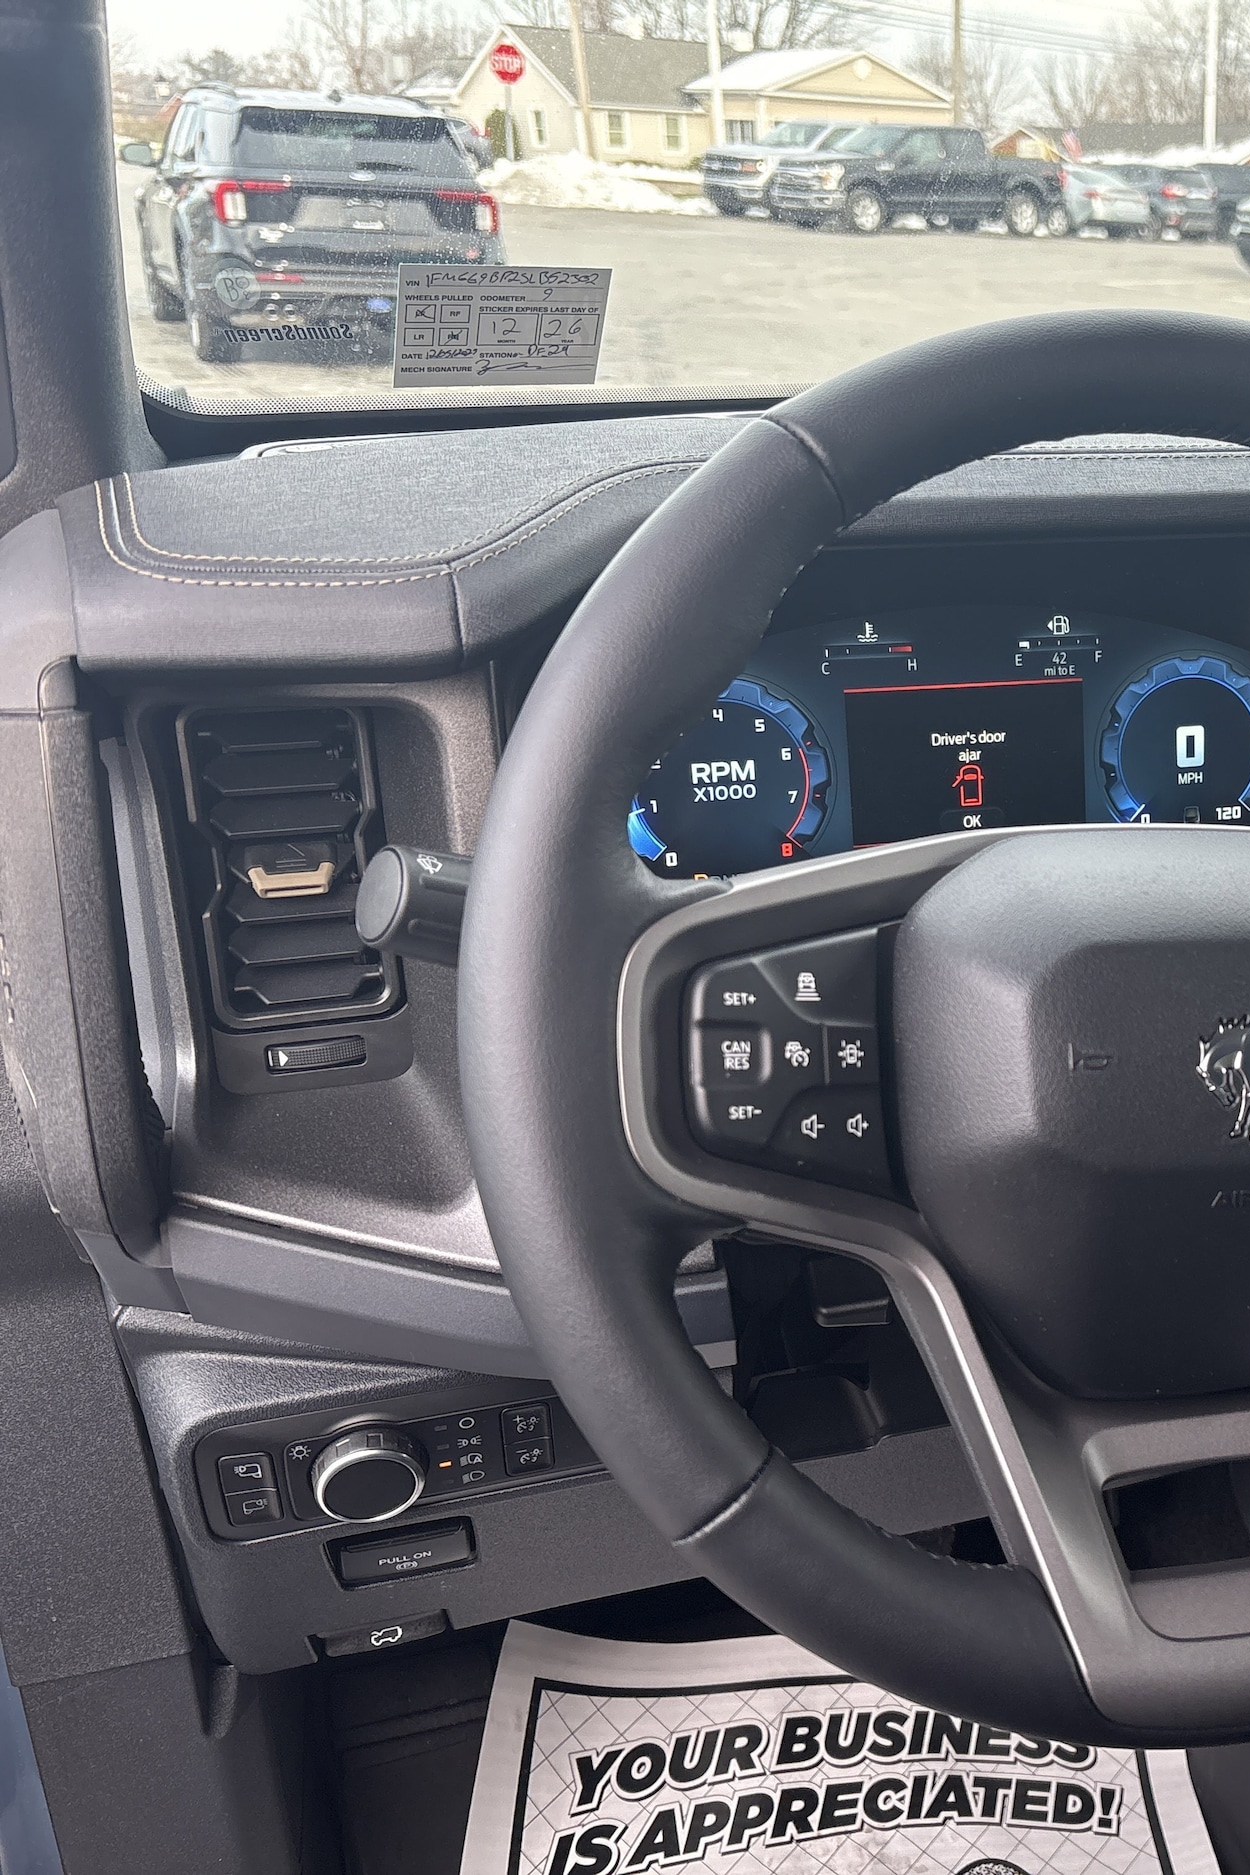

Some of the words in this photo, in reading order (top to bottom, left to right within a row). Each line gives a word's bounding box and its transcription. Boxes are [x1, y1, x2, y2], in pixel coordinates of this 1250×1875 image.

[491, 55, 521, 73] STOP
[543, 288, 553, 302] 9
[492, 318, 522, 336] 12
[543, 318, 583, 339] 26
[1015, 654, 1023, 666] E
[1052, 652, 1067, 665] 42
[1095, 650, 1102, 663] F
[821, 662, 830, 675] C
[907, 659, 917, 671] H
[1045, 666, 1056, 676] mi
[1058, 666, 1068, 676] to
[1069, 665, 1076, 675] E
[712, 708, 724, 722] 4
[754, 718, 766, 732] 5
[931, 731, 977, 747] Driver's
[978, 730, 1006, 744] door
[1176, 725, 1205, 768] 0
[781, 747, 792, 761] 6
[958, 748, 981, 764] ajar
[691, 759, 756, 785] RPM
[1178, 772, 1203, 785] MPH
[693, 784, 757, 803] X1000
[787, 790, 798, 804] 7
[650, 800, 658, 813] 1
[1216, 806, 1242, 821] 120
[963, 814, 982, 829] OK
[781, 843, 793, 857] 8
[665, 852, 678, 867] 0
[723, 992, 757, 1005] SET+
[721, 1041, 751, 1052] CAN
[724, 1056, 750, 1071] RES
[728, 1105, 763, 1120] SET-
[378, 1555, 411, 1566] PULL
[413, 1550, 432, 1559] ON
[574, 1722, 764, 1810] YOUR
[548, 1823, 619, 1875] IS
[627, 1772, 1117, 1867] APPRECIATED!
